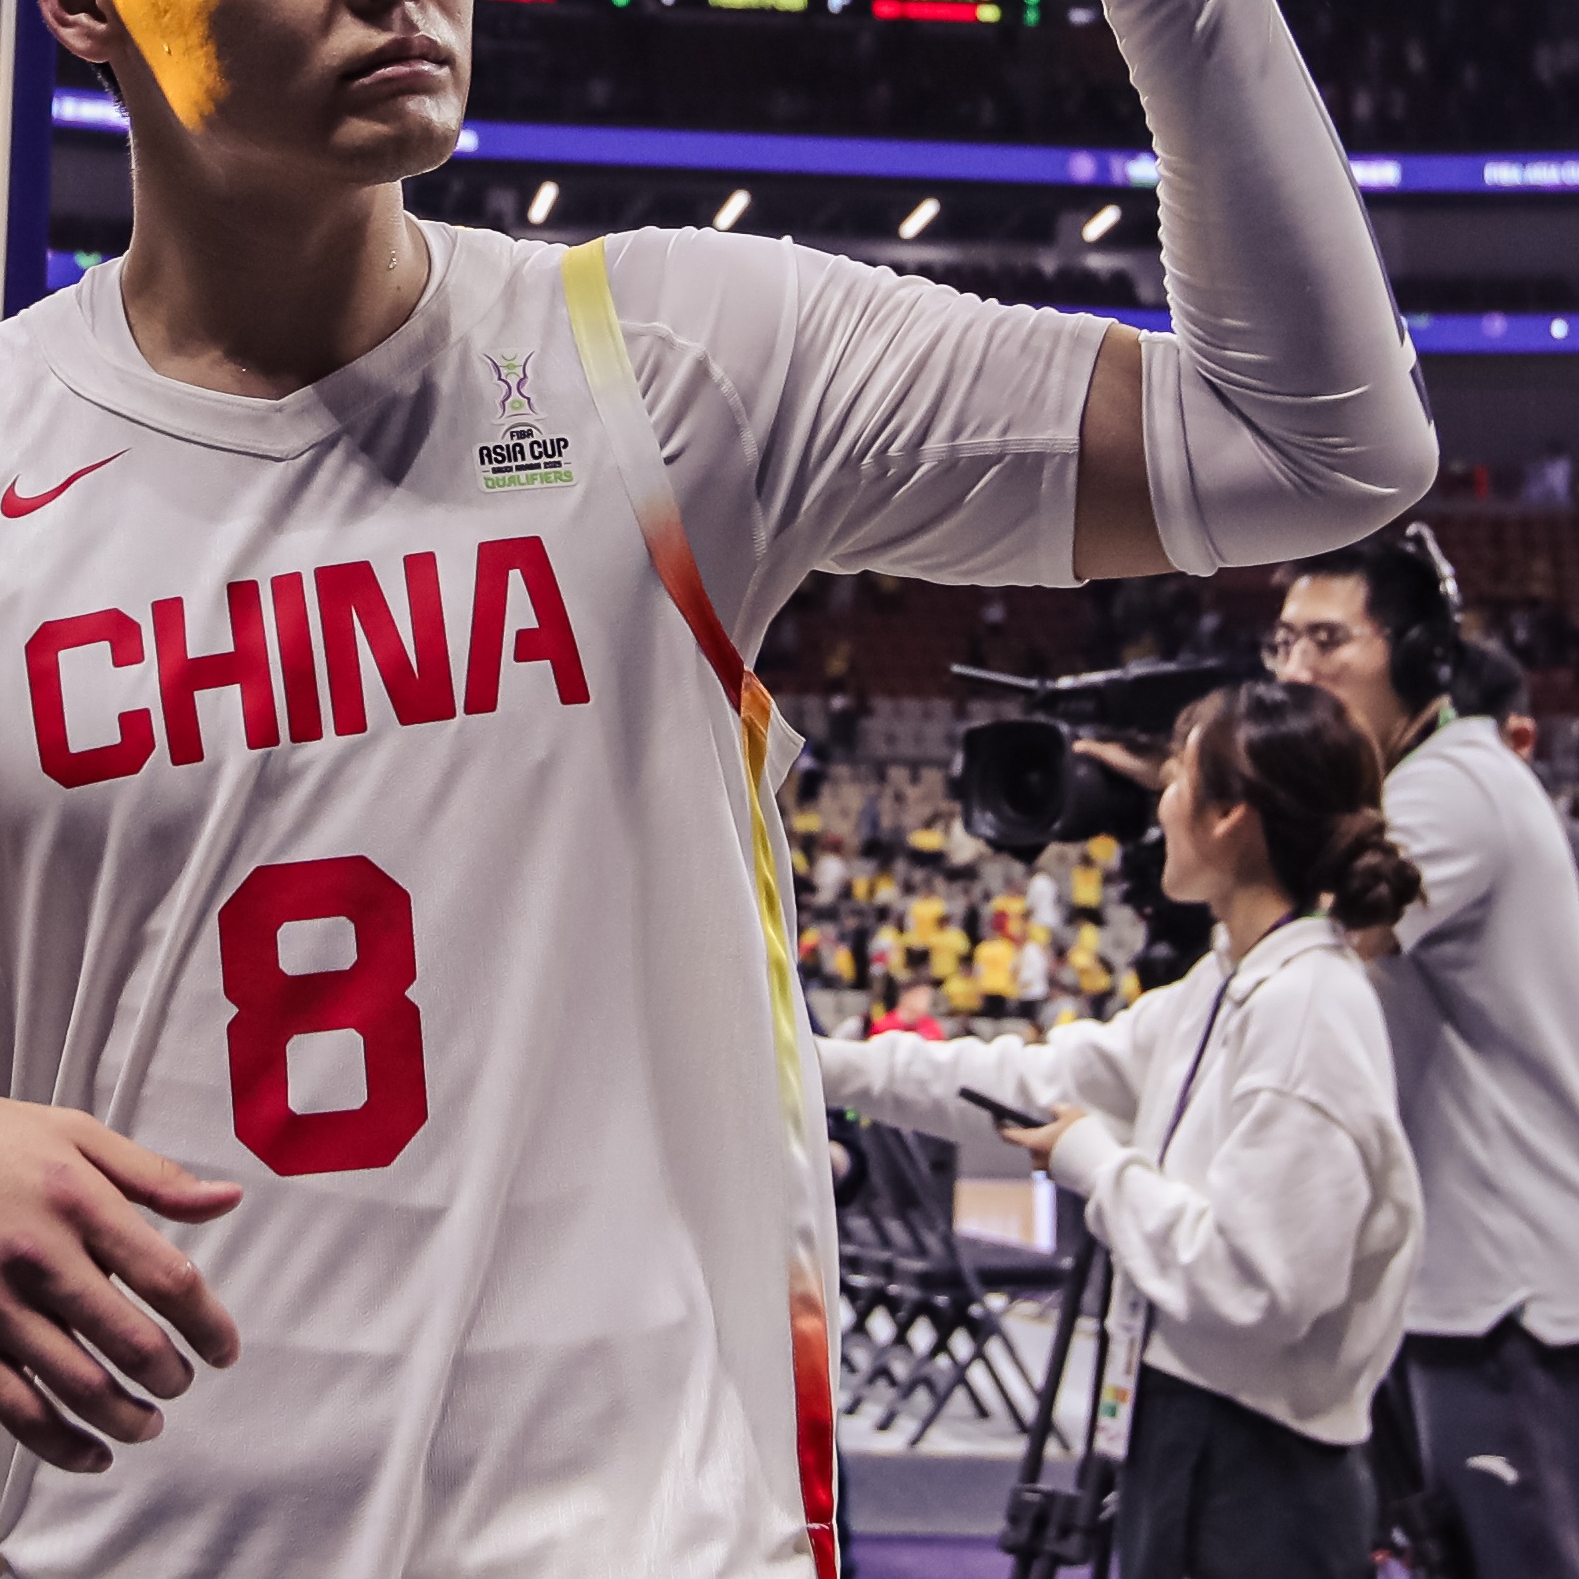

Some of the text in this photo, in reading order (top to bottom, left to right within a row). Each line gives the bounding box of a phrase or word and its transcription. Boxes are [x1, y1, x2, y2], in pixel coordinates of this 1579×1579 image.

[509, 428, 534, 441] FIBA
[478, 437, 569, 466] ASIA CUP
[484, 470, 574, 489] QUALIFIERS
[24, 535, 591, 790] CHINA
[217, 854, 429, 1178] 8
